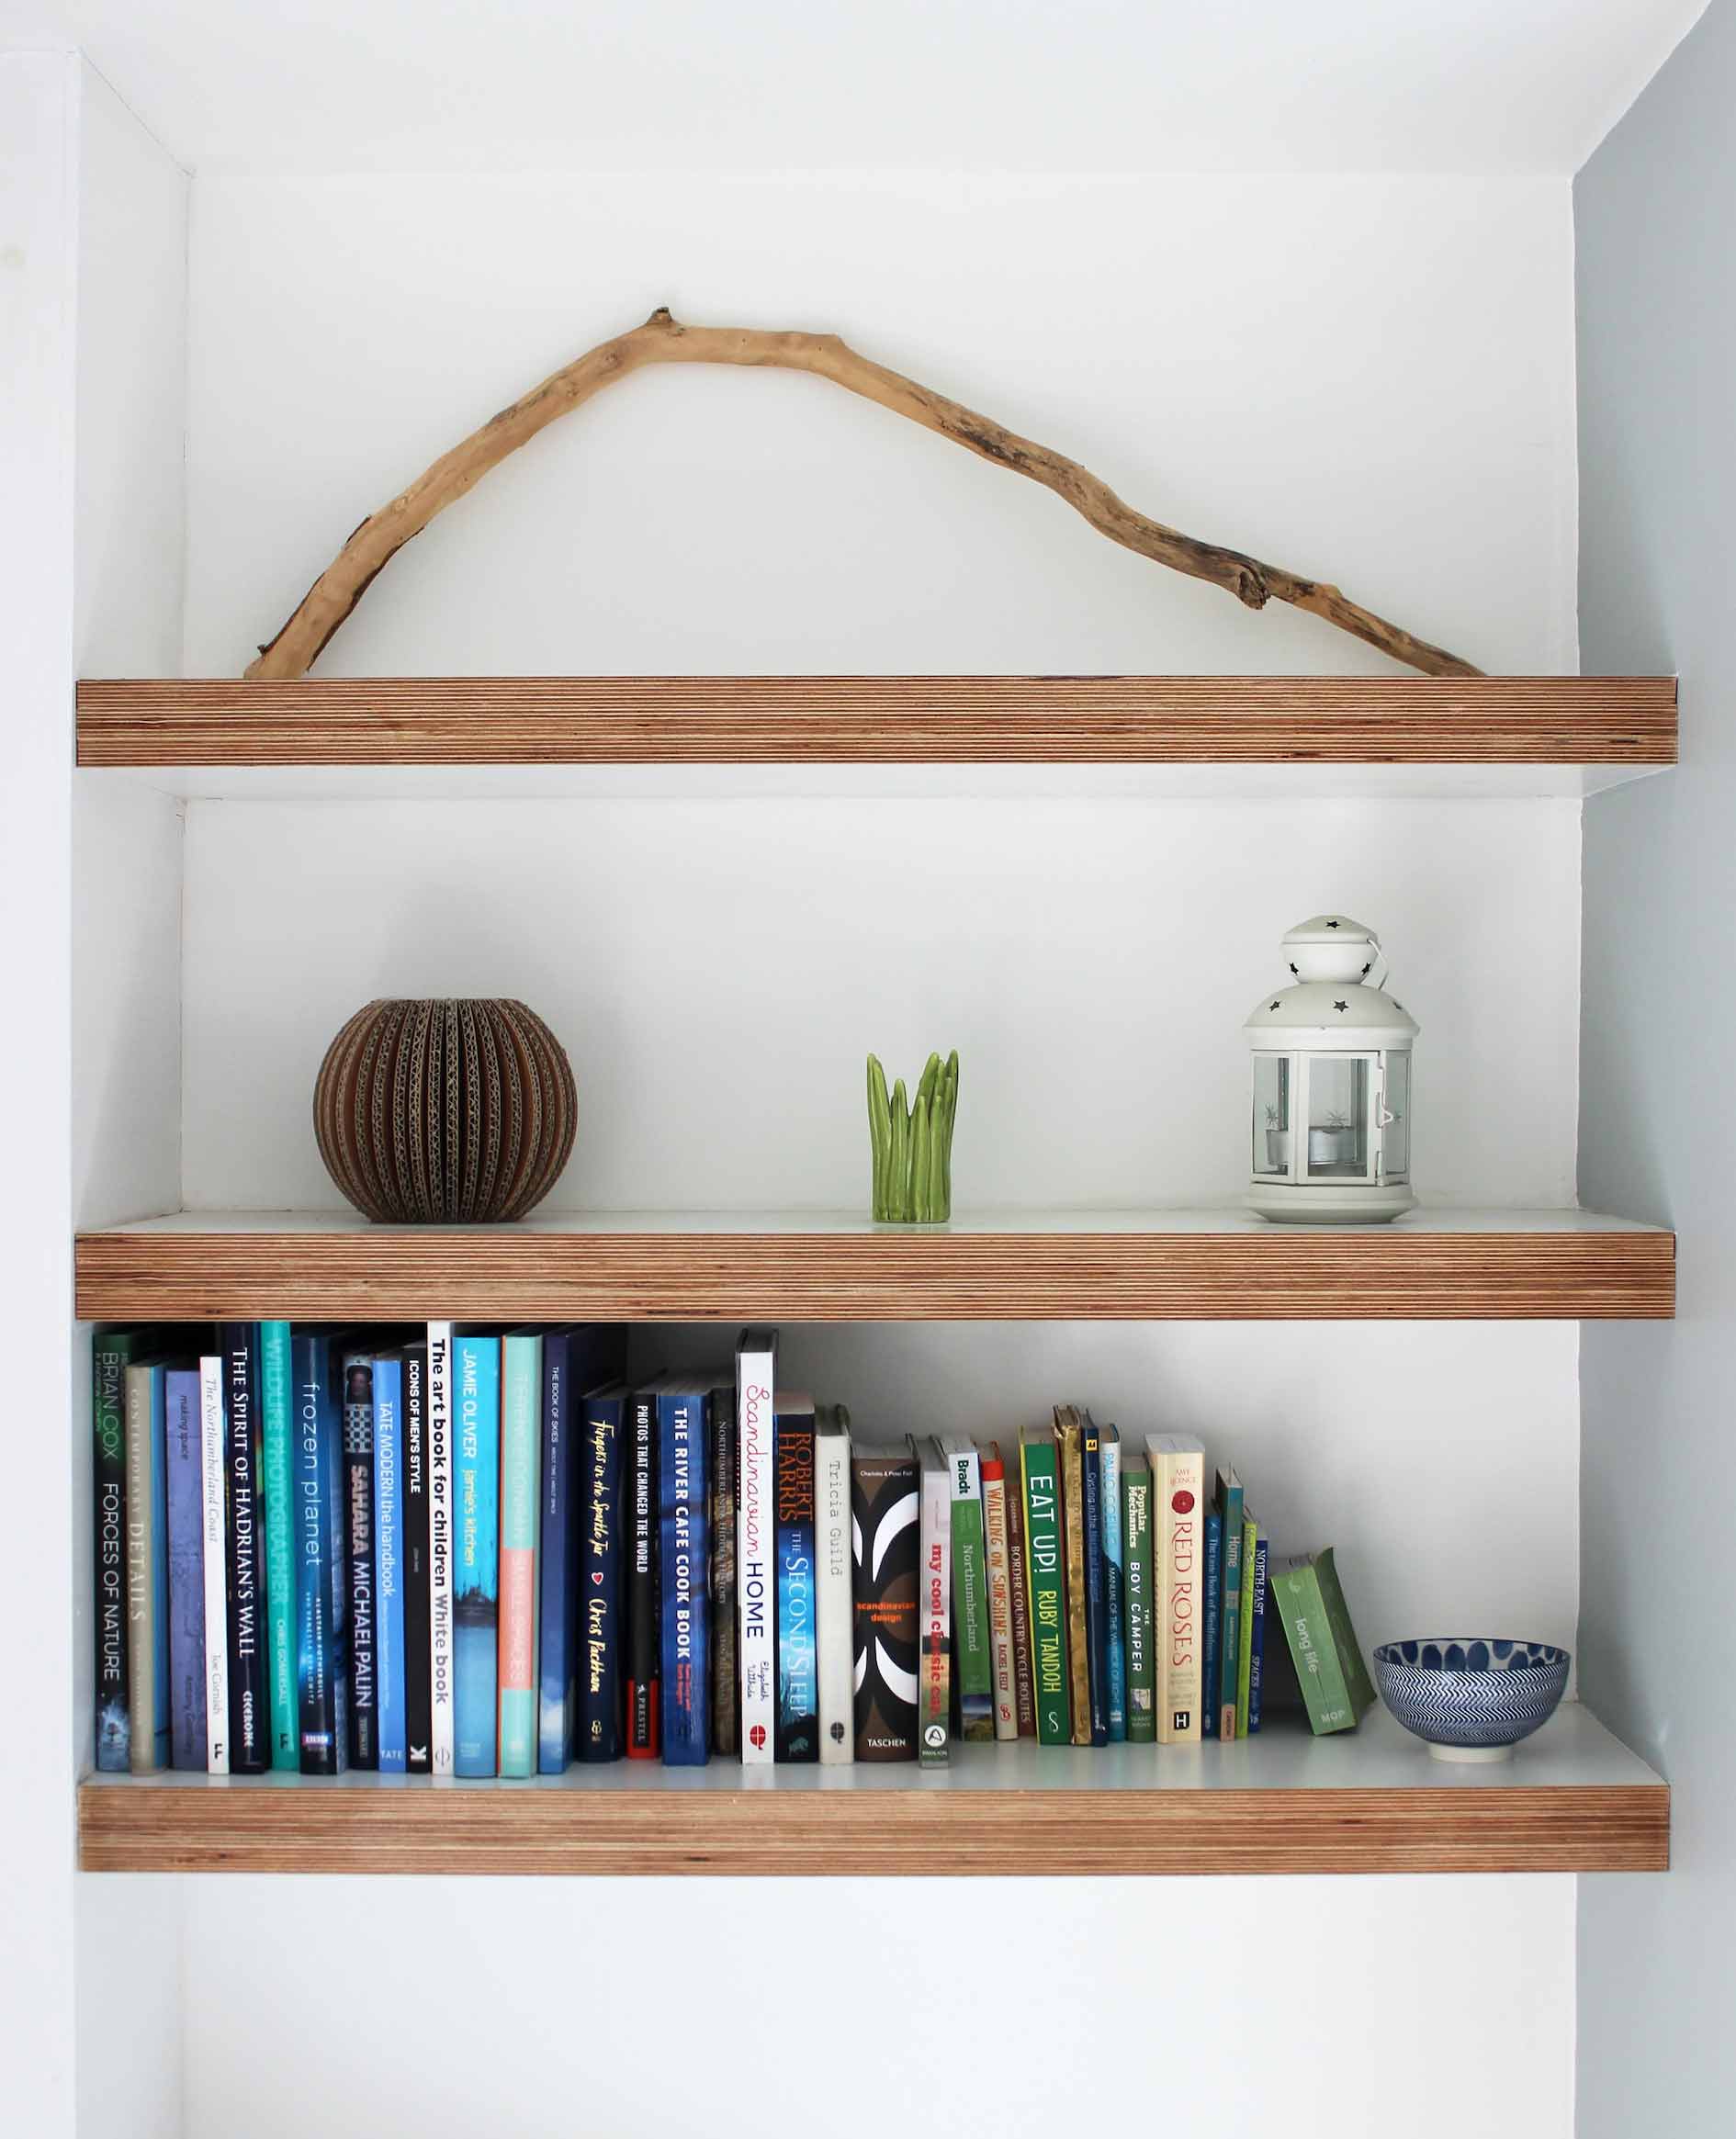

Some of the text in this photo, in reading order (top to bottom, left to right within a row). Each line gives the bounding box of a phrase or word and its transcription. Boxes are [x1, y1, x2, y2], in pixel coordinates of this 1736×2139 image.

[102, 1352, 118, 1459] BRIAN COX
[178, 1395, 189, 1460] making space
[378, 1402, 393, 1431] TATE
[409, 1359, 422, 1493] ICONS OF MEN'S STYLE
[551, 1366, 559, 1443] THE BOOK OF SKIES
[674, 1407, 688, 1441] THE
[206, 1378, 219, 1543] The Northumberland Coast
[265, 1337, 288, 1604] WILDLIFE PHOTOGRAPHER
[301, 1382, 323, 1566] frozen planet
[379, 1434, 395, 1497] MODERN
[462, 1348, 477, 1567] JAMIE OLIVER jamie's kitchen
[594, 1465, 605, 1478] in
[674, 1447, 689, 1500] RIVER
[780, 1434, 796, 1522] HARRIS
[795, 1433, 813, 1521] ROBERT
[957, 1459, 971, 1495] Bradt
[130, 1388, 145, 1621] CONTEMPORARY DETAILS
[231, 1347, 254, 1659] THE SPIRIT OF HADRIAN'S WALL
[351, 1465, 369, 1555] SAHARA
[381, 1499, 395, 1523] the
[593, 1480, 610, 1497] the
[636, 1405, 648, 1573] PHOTOS THAT CHANGED THE WORLD
[746, 1384, 770, 1638] Scandinavian HOME
[829, 1459, 843, 1576] Tricia Guild
[987, 1487, 1004, 1546] WALKING
[1128, 1486, 1139, 1548] Mechanics
[1138, 1486, 1147, 1532] Popular
[432, 1339, 449, 1705] The art book for children White book
[675, 1506, 689, 1548] CAFE
[791, 1533, 802, 1552] THE
[1171, 1521, 1193, 1573] RED
[1208, 1537, 1219, 1554] The
[381, 1525, 397, 1598] handbook
[676, 1554, 690, 1603] COOK
[928, 1544, 941, 1573] my
[991, 1549, 1003, 1568] ON
[1011, 1546, 1023, 1589] BORDER
[1227, 1535, 1240, 1568] Home
[103, 1483, 119, 1681] FORCES OF NATURE
[353, 1561, 371, 1649] MICHAEL
[856, 1602, 916, 1611] scandinavian
[930, 1578, 944, 1616] cool
[963, 1545, 978, 1652] Northumberland
[990, 1573, 1008, 1638] SUNSHINE
[1030, 1475, 1061, 1694] EAT UP! RUBY TANDOH
[588, 1598, 607, 1636] Chris
[676, 1609, 691, 1659] BOOK
[785, 1557, 810, 1717] SECOND SLEEP
[871, 1613, 902, 1623] design
[1013, 1591, 1026, 1641] COUNTRY
[1130, 1561, 1143, 1672] BOY CAMPER
[1170, 1582, 1192, 1666] ROSES
[1017, 1646, 1028, 1682] CYCLE
[1295, 1618, 1319, 1673] long life
[355, 1651, 372, 1708] PALIN
[1019, 1683, 1031, 1723] ROUTES
[867, 1738, 907, 1748] TASCHEN
[1320, 1710, 1346, 1724] MOP
